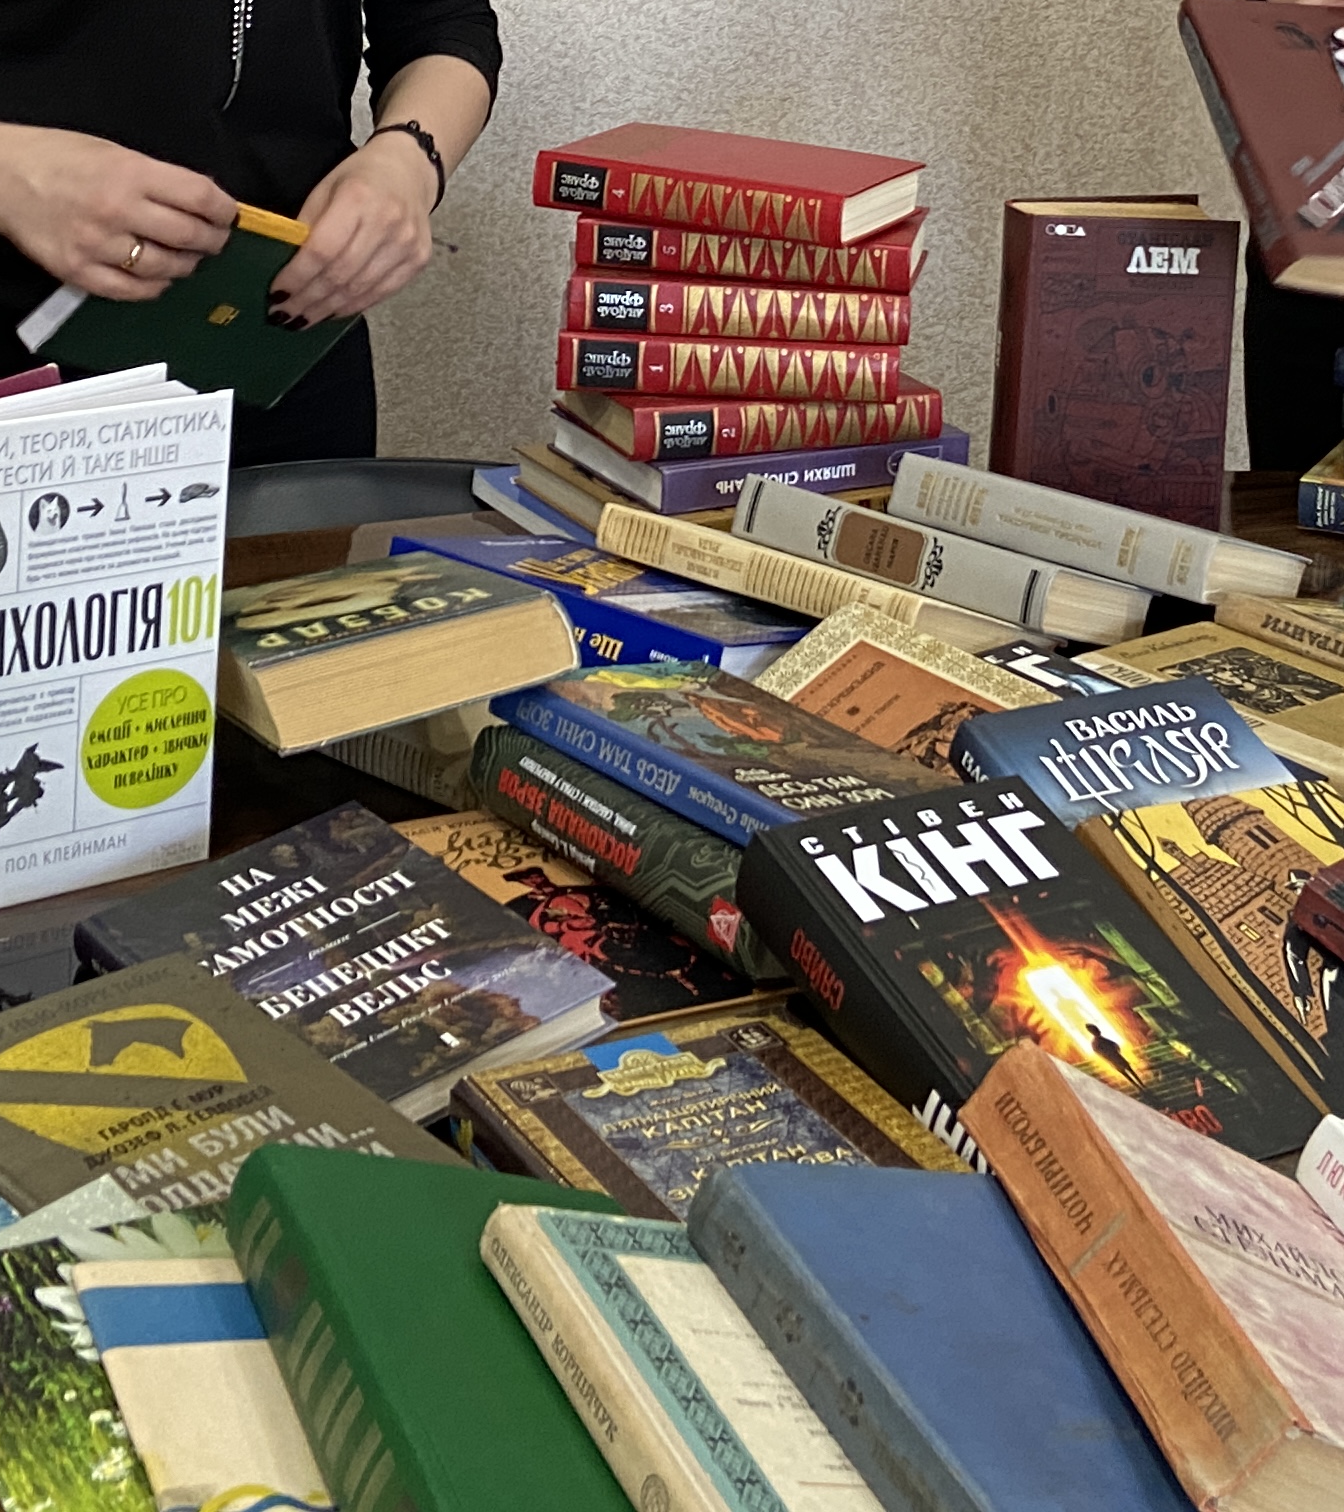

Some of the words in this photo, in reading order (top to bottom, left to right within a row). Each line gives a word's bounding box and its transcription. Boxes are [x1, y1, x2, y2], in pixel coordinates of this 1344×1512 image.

[20, 428, 94, 458] ТЕОРІЯ,
[97, 408, 227, 448] СТАТИСТИКА,
[60, 452, 77, 479] Й
[83, 449, 129, 475] ТАКЕ
[803, 463, 856, 482] ШЛЯХИ
[166, 572, 218, 646] 101
[256, 587, 494, 648] КОБЗАР
[588, 632, 624, 662] Ще
[116, 692, 149, 717] УСЕ
[149, 684, 188, 712] ПРО
[513, 695, 555, 734] ЗОРІ
[1064, 700, 1198, 744] ВАСИЛЬ
[552, 714, 600, 758] СИНІ
[599, 739, 640, 779] ТАМ
[493, 766, 549, 817] ЗБРОЯ
[635, 755, 682, 800] ДЕСЬ
[541, 797, 645, 876] ДОСКОНАЛА
[799, 789, 1026, 858] СТІВЕН
[4, 850, 39, 875] ПОЛ
[42, 833, 129, 868] КЛЕЙНМАН
[814, 808, 1060, 924] КІНГ
[217, 864, 277, 899] НА
[219, 873, 330, 934] МЕЖІ
[255, 914, 454, 1021] БЕНЕДИКТ
[325, 958, 454, 1029] ВЕЛЬС
[639, 1100, 769, 1140] КАПІТАН
[994, 1089, 1047, 1161] БРОДИ
[113, 1147, 190, 1191] МИ
[187, 1103, 298, 1158] БУЛИ
[1032, 1155, 1094, 1238] ЧОТИРИ
[1101, 1248, 1174, 1352] СТЕЛЬМАХ
